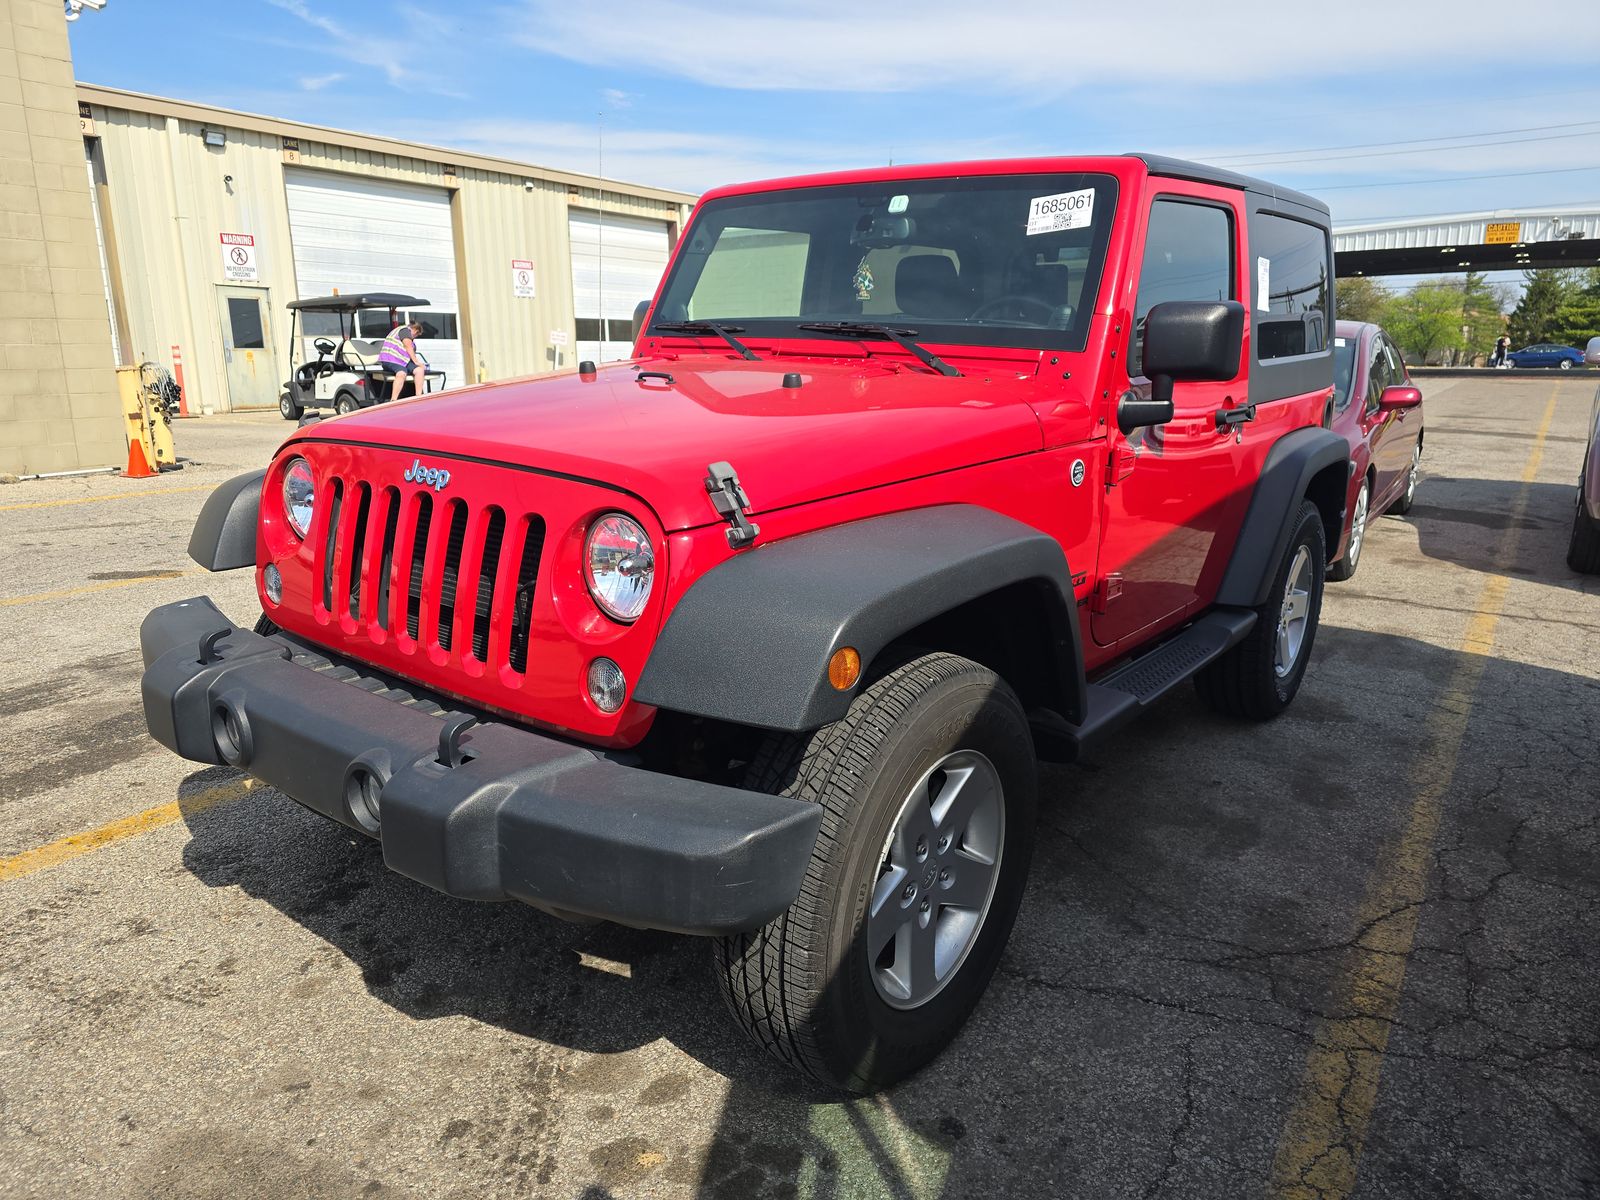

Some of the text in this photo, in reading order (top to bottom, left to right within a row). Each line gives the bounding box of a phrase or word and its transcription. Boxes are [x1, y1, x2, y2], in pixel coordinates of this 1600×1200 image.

[80, 107, 91, 115] NE
[80, 120, 86, 130] 9
[283, 139, 298, 148] LANE
[289, 151, 294, 161] 8
[1034, 194, 1092, 215] 1685061
[1488, 223, 1520, 232] CAUTION
[222, 234, 252, 246] WARNING
[404, 459, 450, 492] Jeep
